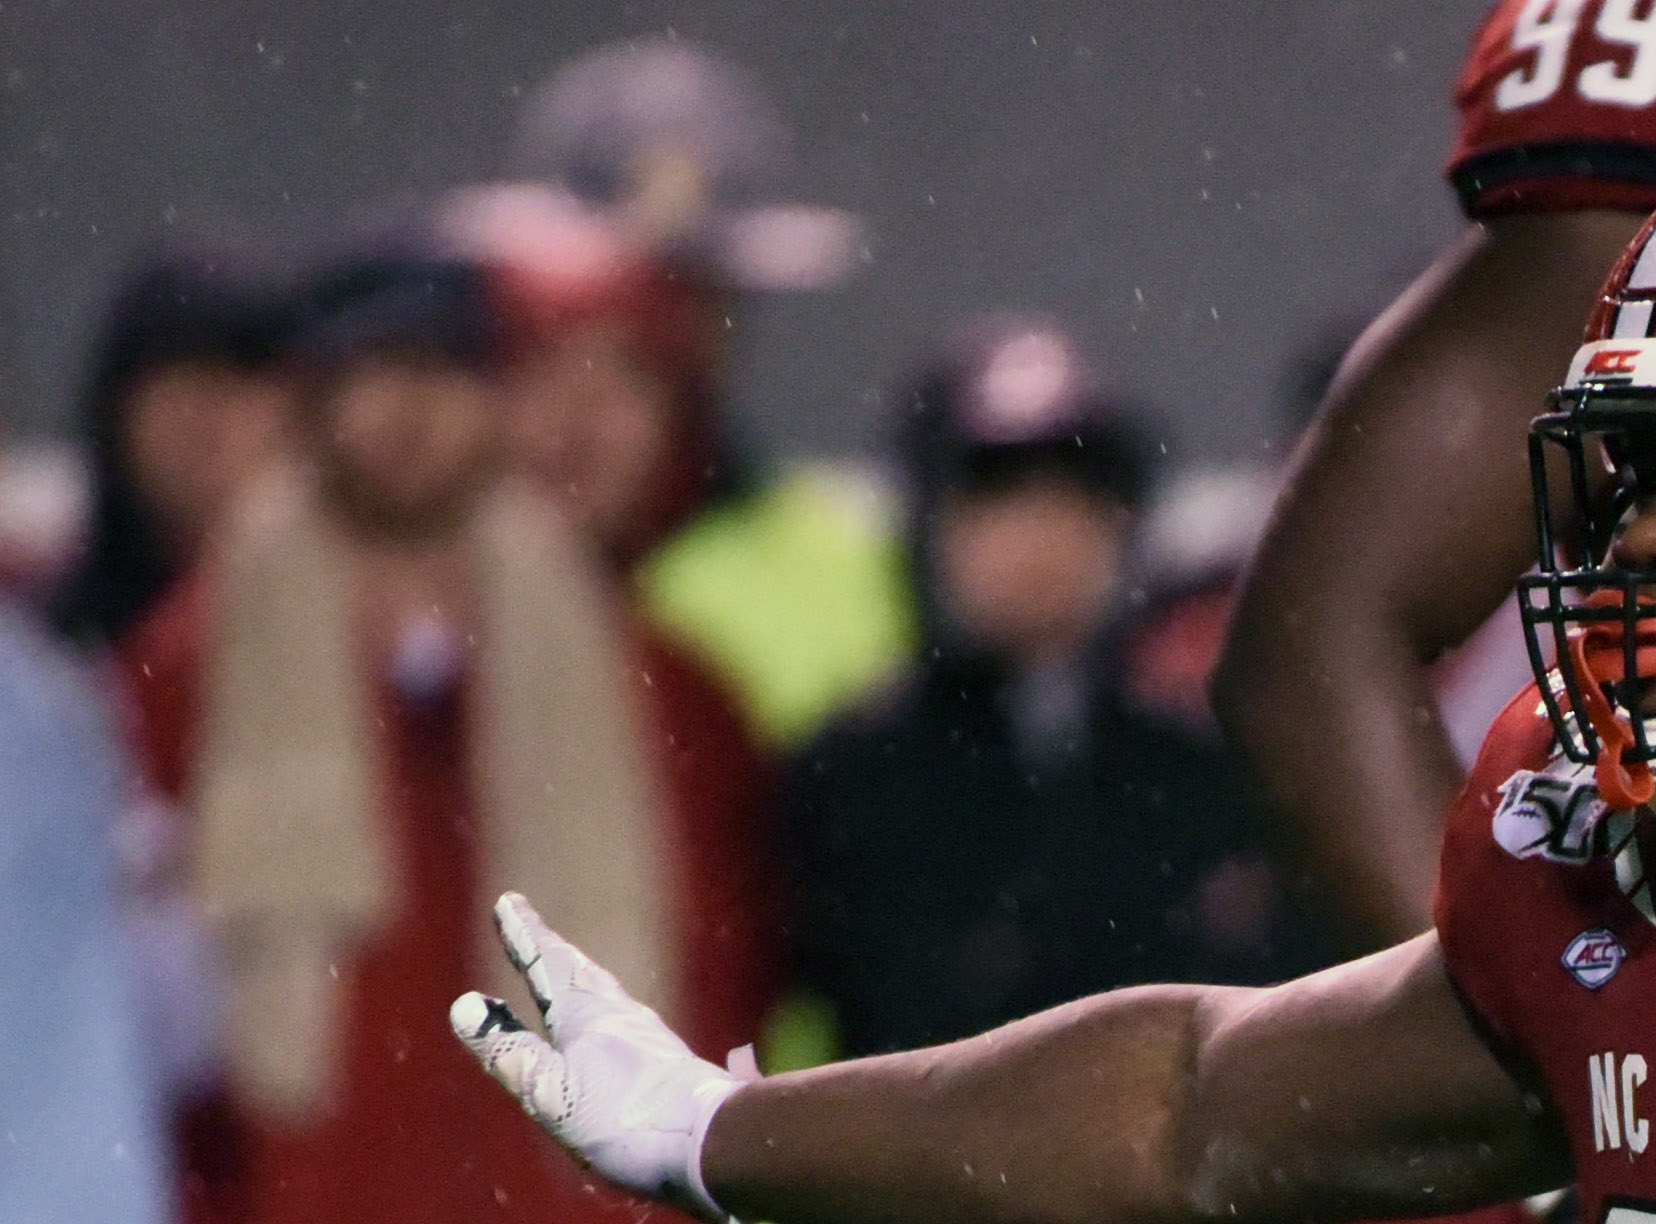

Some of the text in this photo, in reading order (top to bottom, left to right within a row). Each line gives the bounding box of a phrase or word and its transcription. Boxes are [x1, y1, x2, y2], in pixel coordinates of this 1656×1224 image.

[1584, 350, 1643, 374] ACC
[1575, 942, 1616, 964] ACC
[1589, 1051, 1649, 1154] NC
